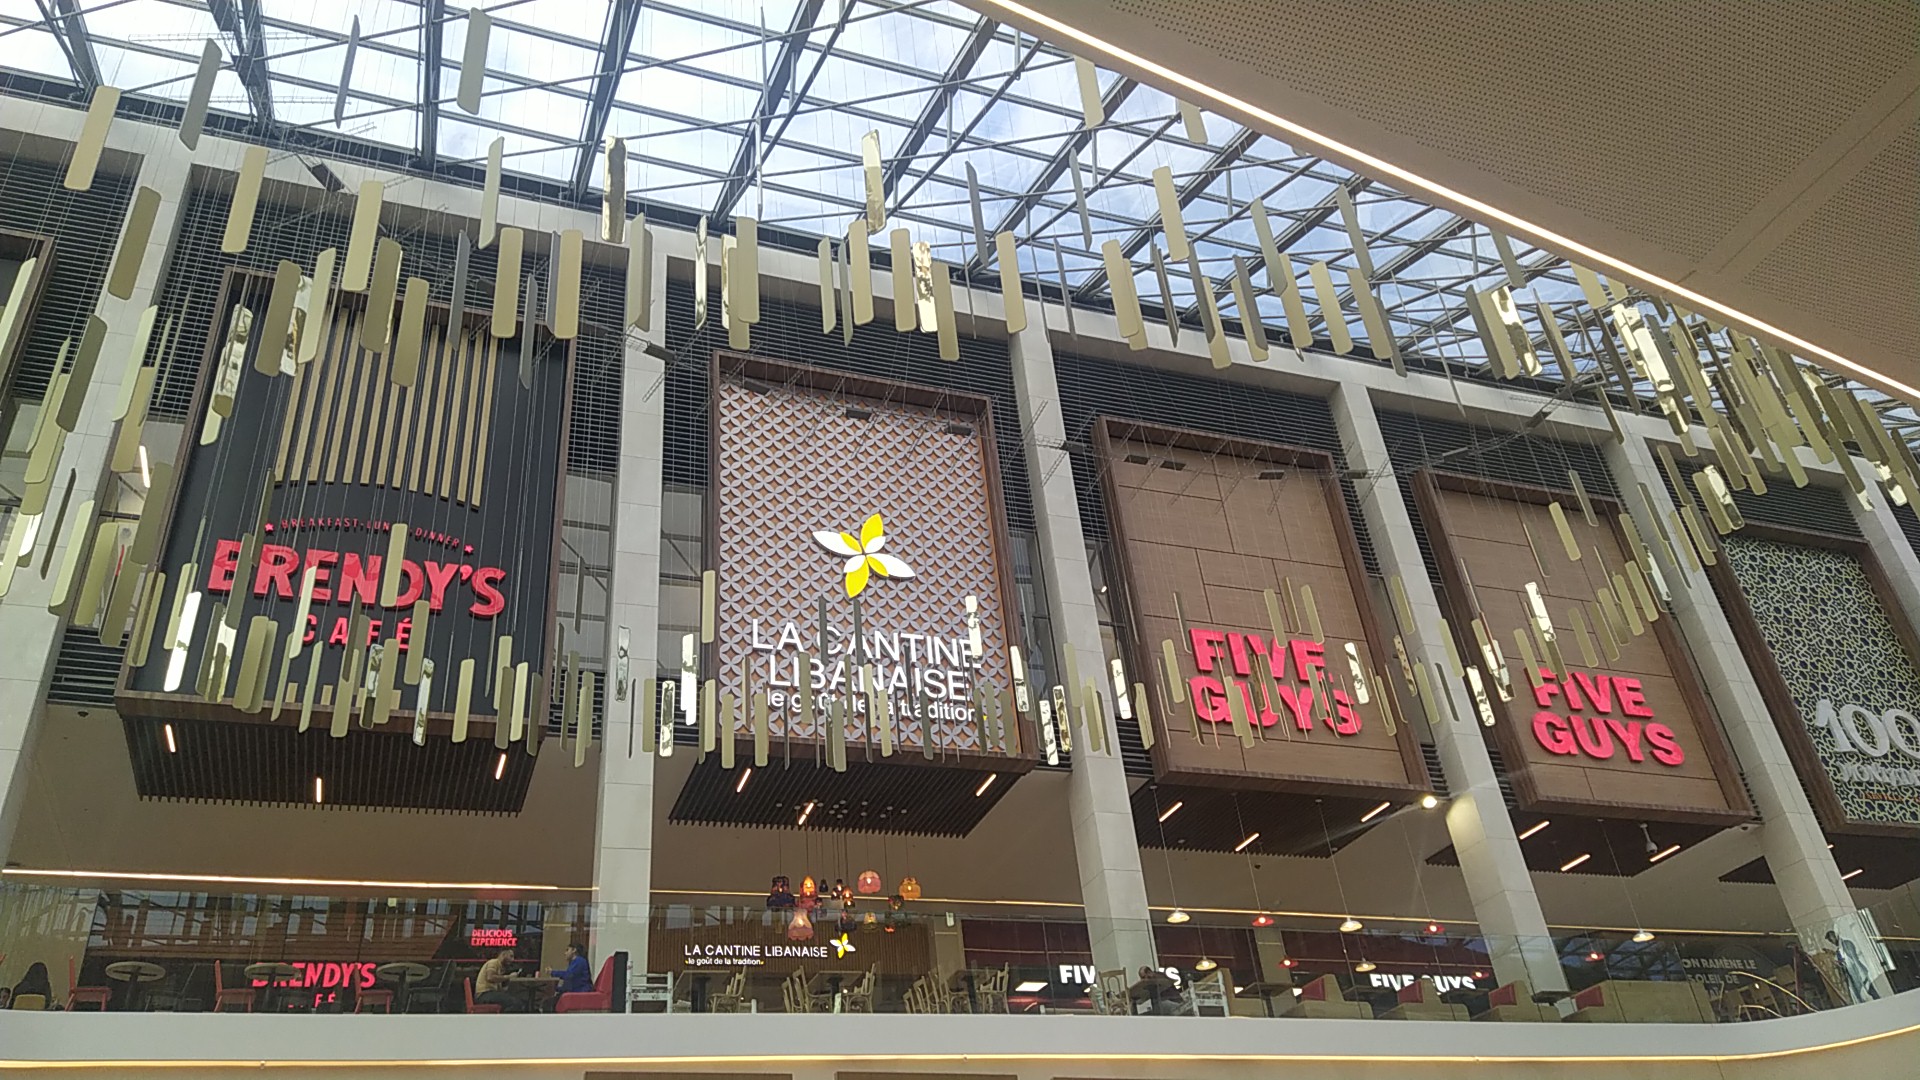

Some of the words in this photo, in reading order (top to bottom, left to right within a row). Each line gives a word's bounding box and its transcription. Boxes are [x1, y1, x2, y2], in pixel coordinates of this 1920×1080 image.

[281, 518, 359, 529] BREAKFAST
[415, 527, 461, 547] DINNER
[207, 539, 506, 617] BRENDY'S
[752, 618, 805, 652] LA
[817, 626, 982, 669] CANTINE
[1189, 628, 1334, 684] FIVE
[769, 655, 971, 701] LIBANAISE
[1524, 667, 1655, 718] FIVE
[767, 688, 785, 708] le
[1189, 676, 1362, 735] GUYS
[1532, 711, 1685, 766] GUYS
[471, 937, 518, 947] EXPERIENCE
[472, 929, 513, 938] DELICIOUS
[684, 944, 702, 956] LA
[705, 944, 761, 957] CANTINE
[764, 945, 828, 958] LIBANAISE
[688, 957, 696, 965] le
[696, 956, 713, 966] goût
[714, 957, 723, 965] de
[724, 957, 732, 965] la
[733, 957, 761, 966] tradition
[1702, 956, 1743, 969] RAMÈNE
[1743, 958, 1757, 969] LE
[1059, 965, 1096, 984] FIV
[1726, 975, 1740, 985] DE
